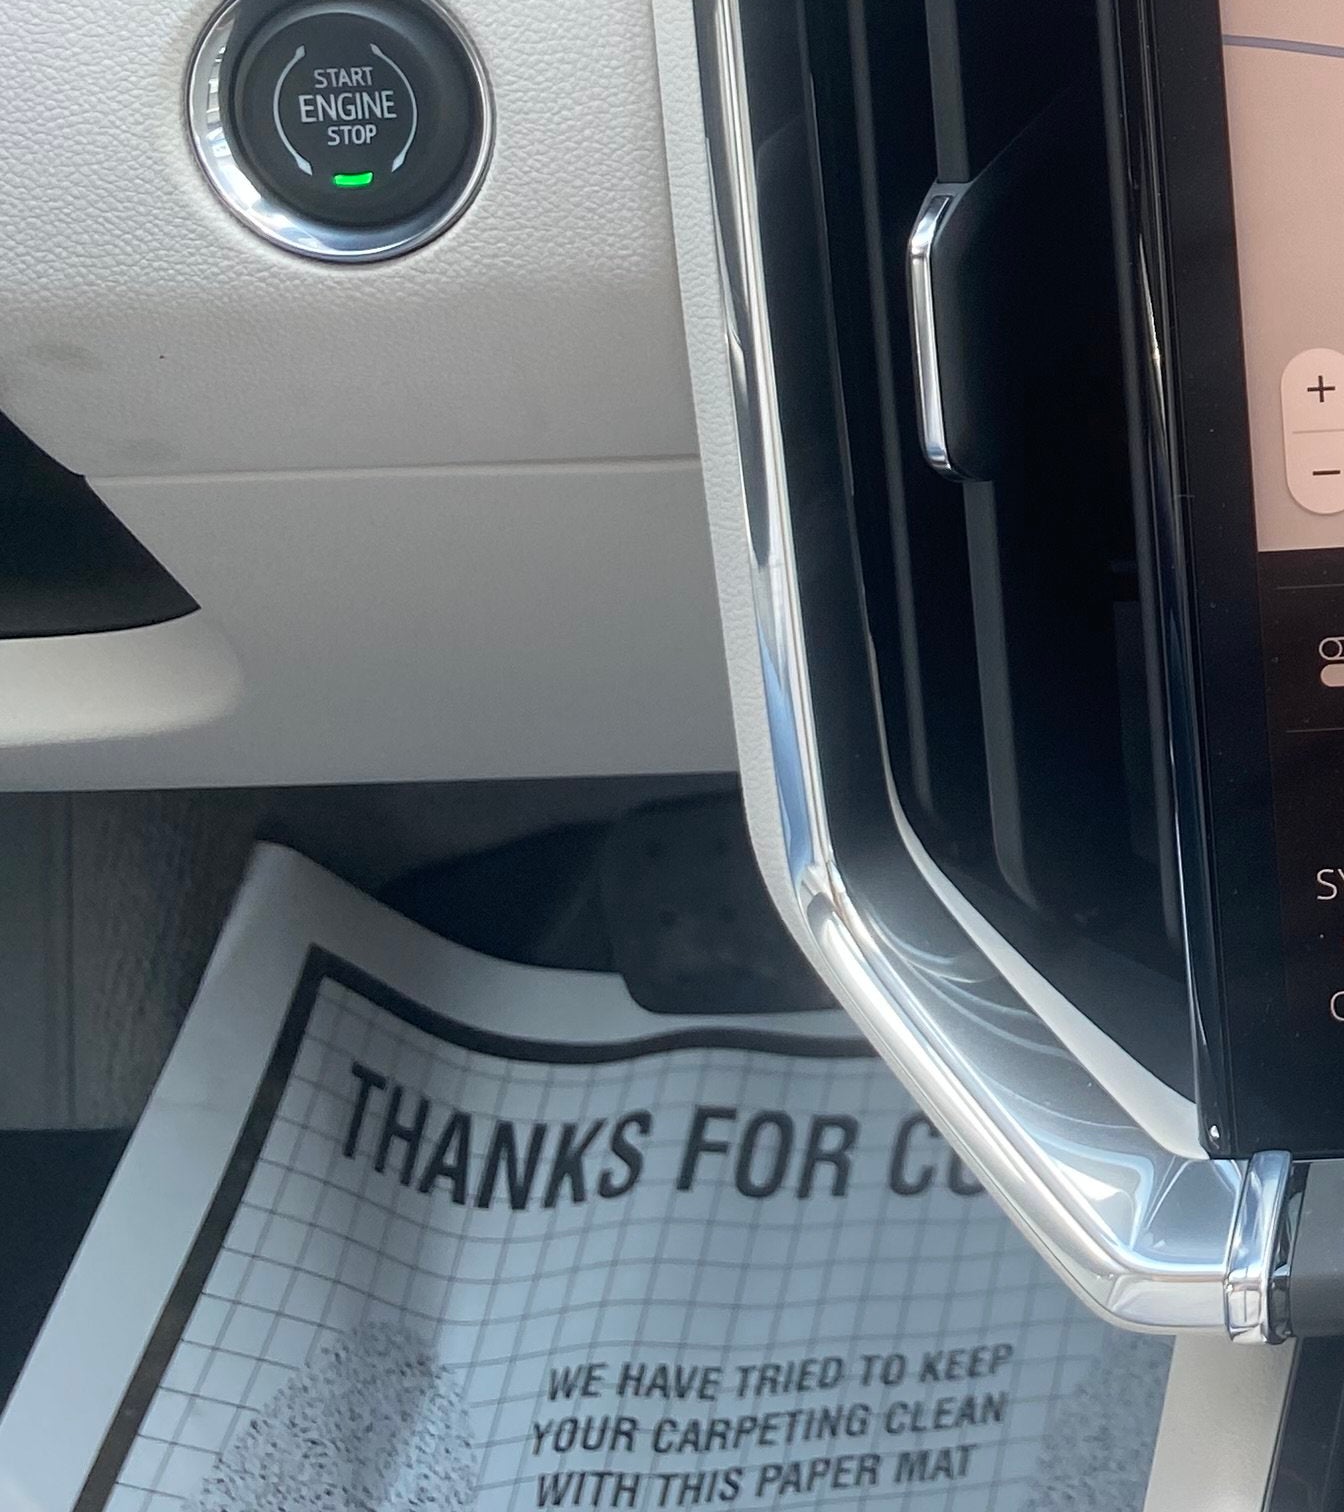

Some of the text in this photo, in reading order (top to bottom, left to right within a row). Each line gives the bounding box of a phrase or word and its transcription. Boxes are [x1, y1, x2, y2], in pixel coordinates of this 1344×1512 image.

[298, 90, 397, 122] ENGINE
[314, 67, 373, 88] START
[327, 125, 377, 146] STOP
[341, 1061, 653, 1211] THANKS
[676, 1106, 860, 1198] FOR
[548, 1343, 1014, 1401] WE HAVE TRIED TO KEEP
[531, 1392, 1009, 1456] YOUR CARPETING CLEAN
[536, 1444, 978, 1508] WITH THIS PAPER MAT
